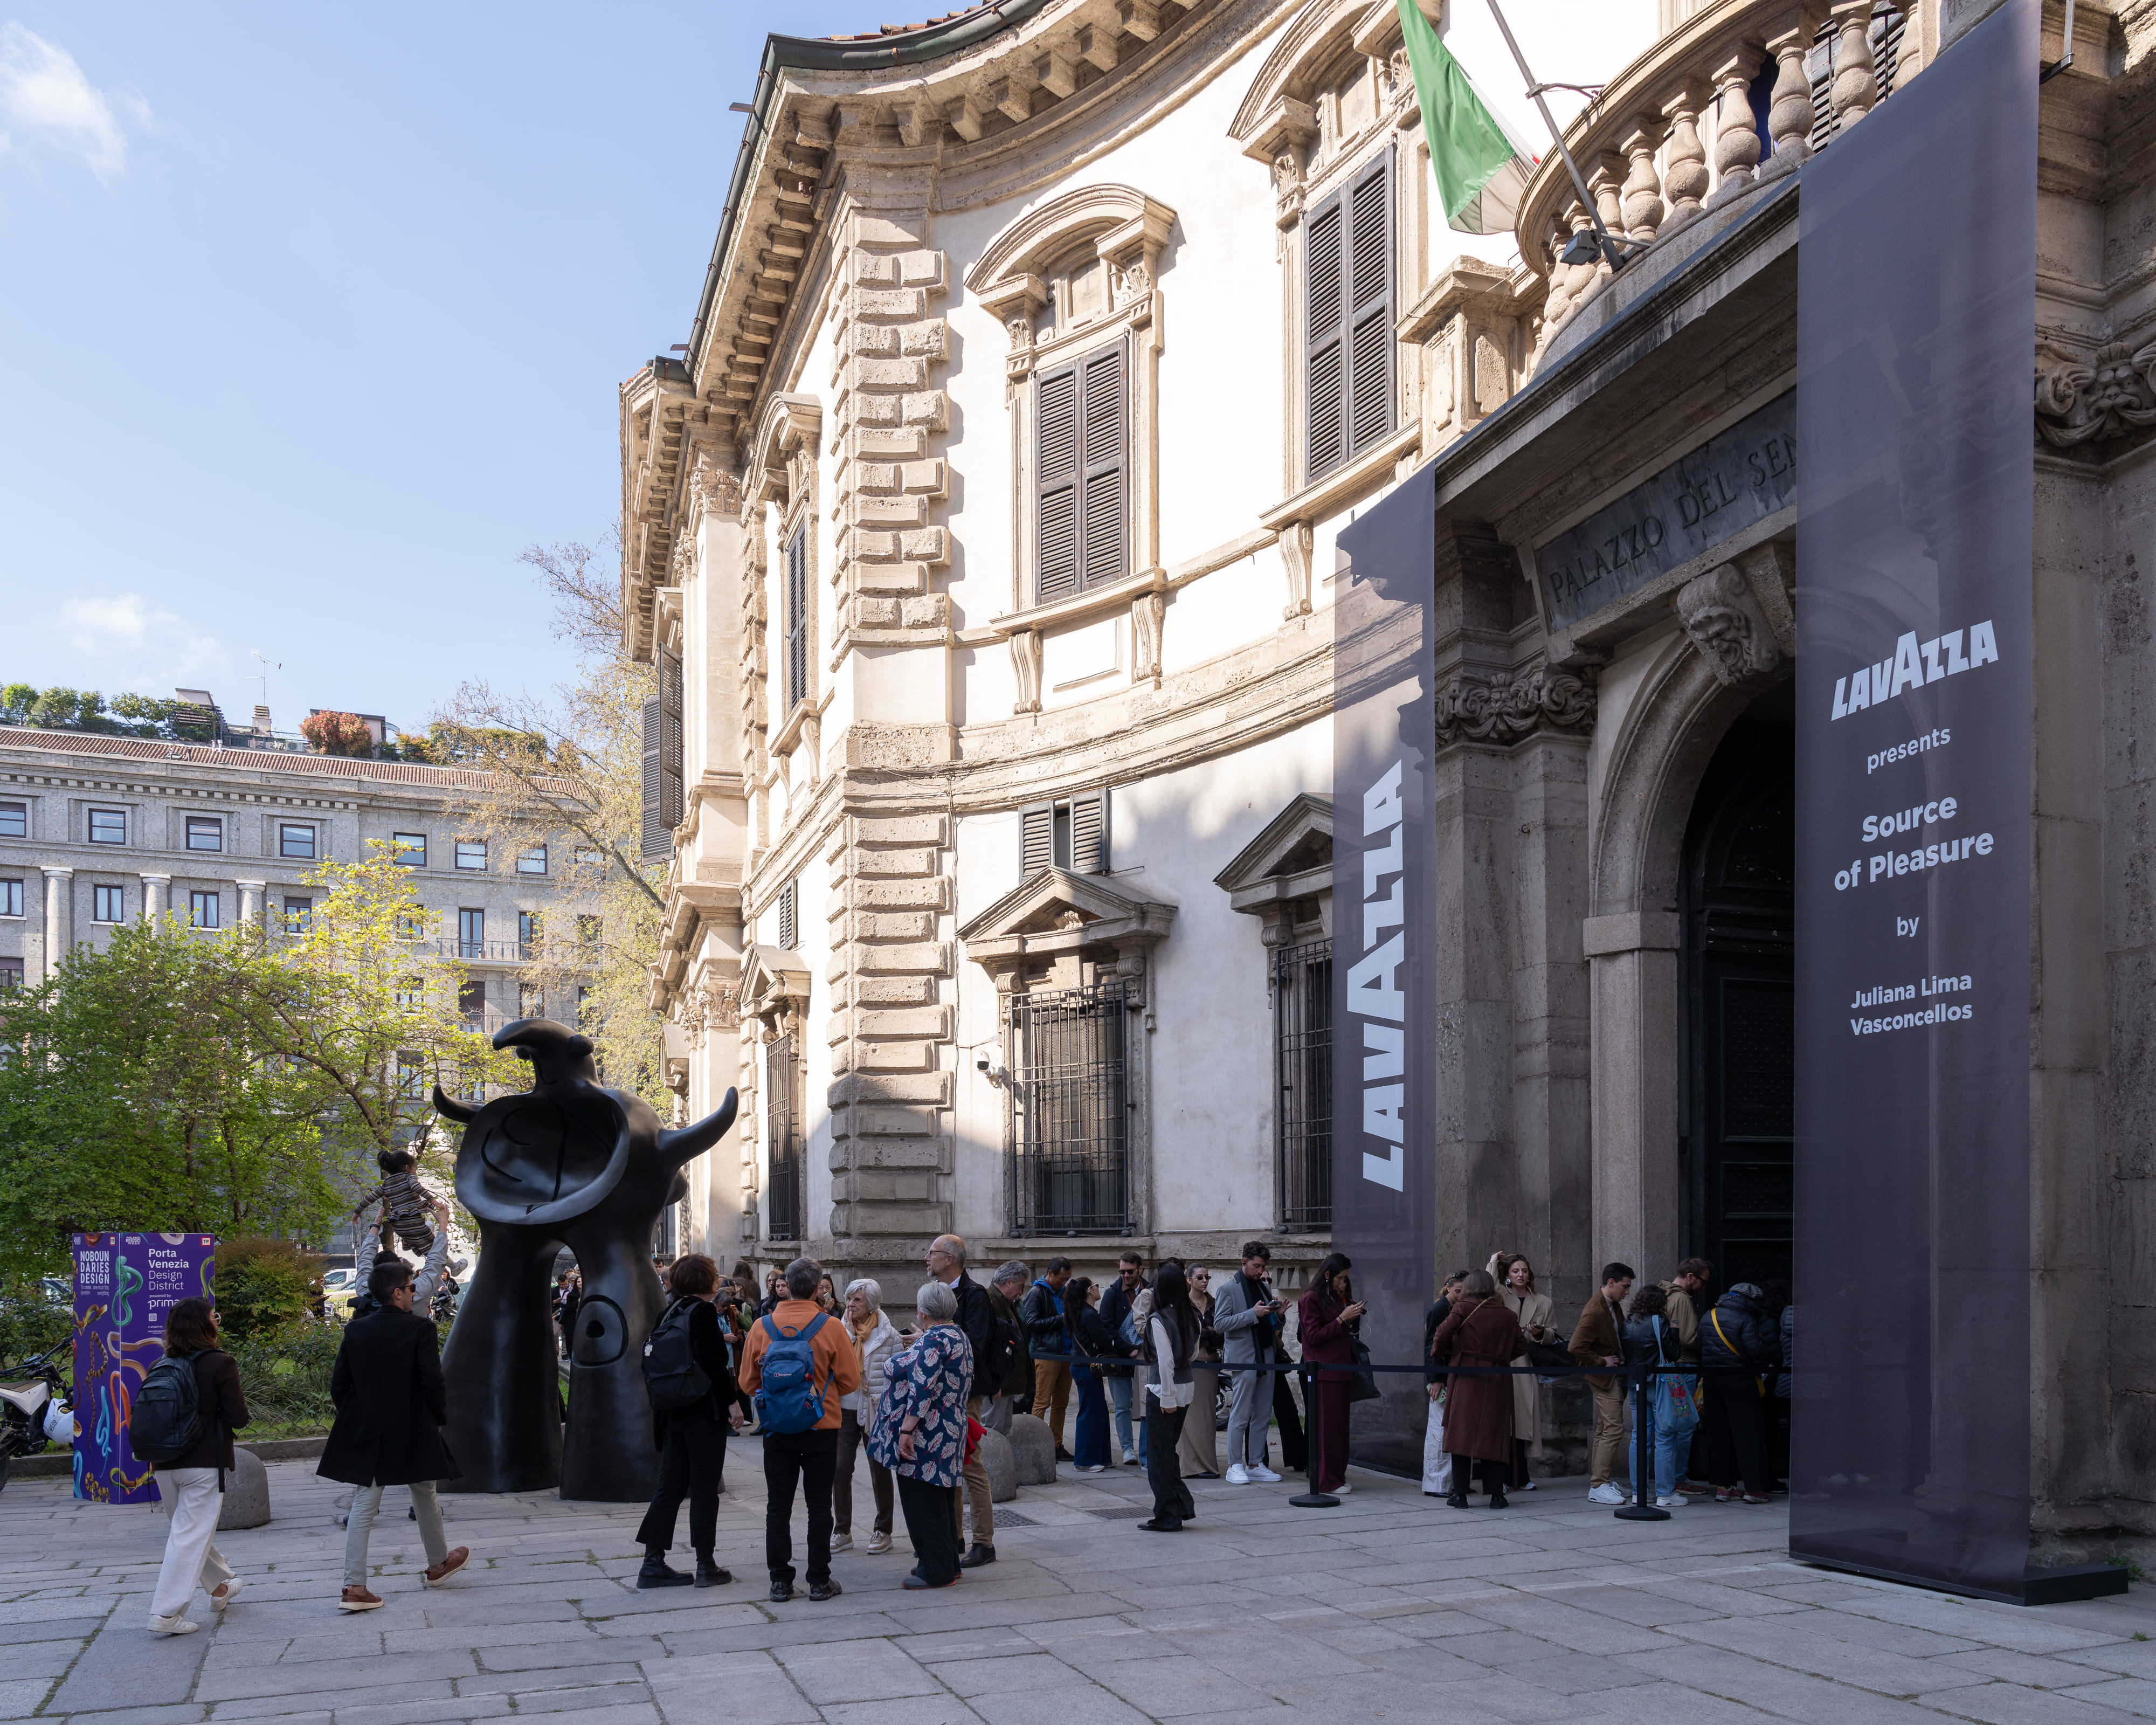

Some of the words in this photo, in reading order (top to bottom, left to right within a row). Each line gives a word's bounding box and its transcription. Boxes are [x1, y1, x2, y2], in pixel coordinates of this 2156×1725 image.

[1548, 516, 1663, 603] PALAZZO
[1676, 473, 1737, 529] DEL
[1747, 432, 1797, 487] SEN
[1831, 620, 1998, 721] LAVAZZA
[1868, 728, 1951, 775] presents
[1862, 797, 1957, 842] Source
[1834, 859, 1861, 891] of
[1870, 833, 1994, 883] Pleasure
[1897, 916, 1919, 937] by
[1347, 758, 1405, 1192] LAVAZZA
[1850, 984, 1915, 1009] Juliana
[1922, 975, 1972, 997] Lima
[1850, 1003, 1972, 1036] Vasconcellos
[80, 1251, 109, 1262] NOBOUN
[148, 1259, 189, 1268] Venezia
[149, 1248, 177, 1258] Porta
[80, 1262, 109, 1273] DARIES
[80, 1273, 109, 1284] DESIGN
[149, 1269, 182, 1281] Design
[149, 1281, 184, 1290] District
